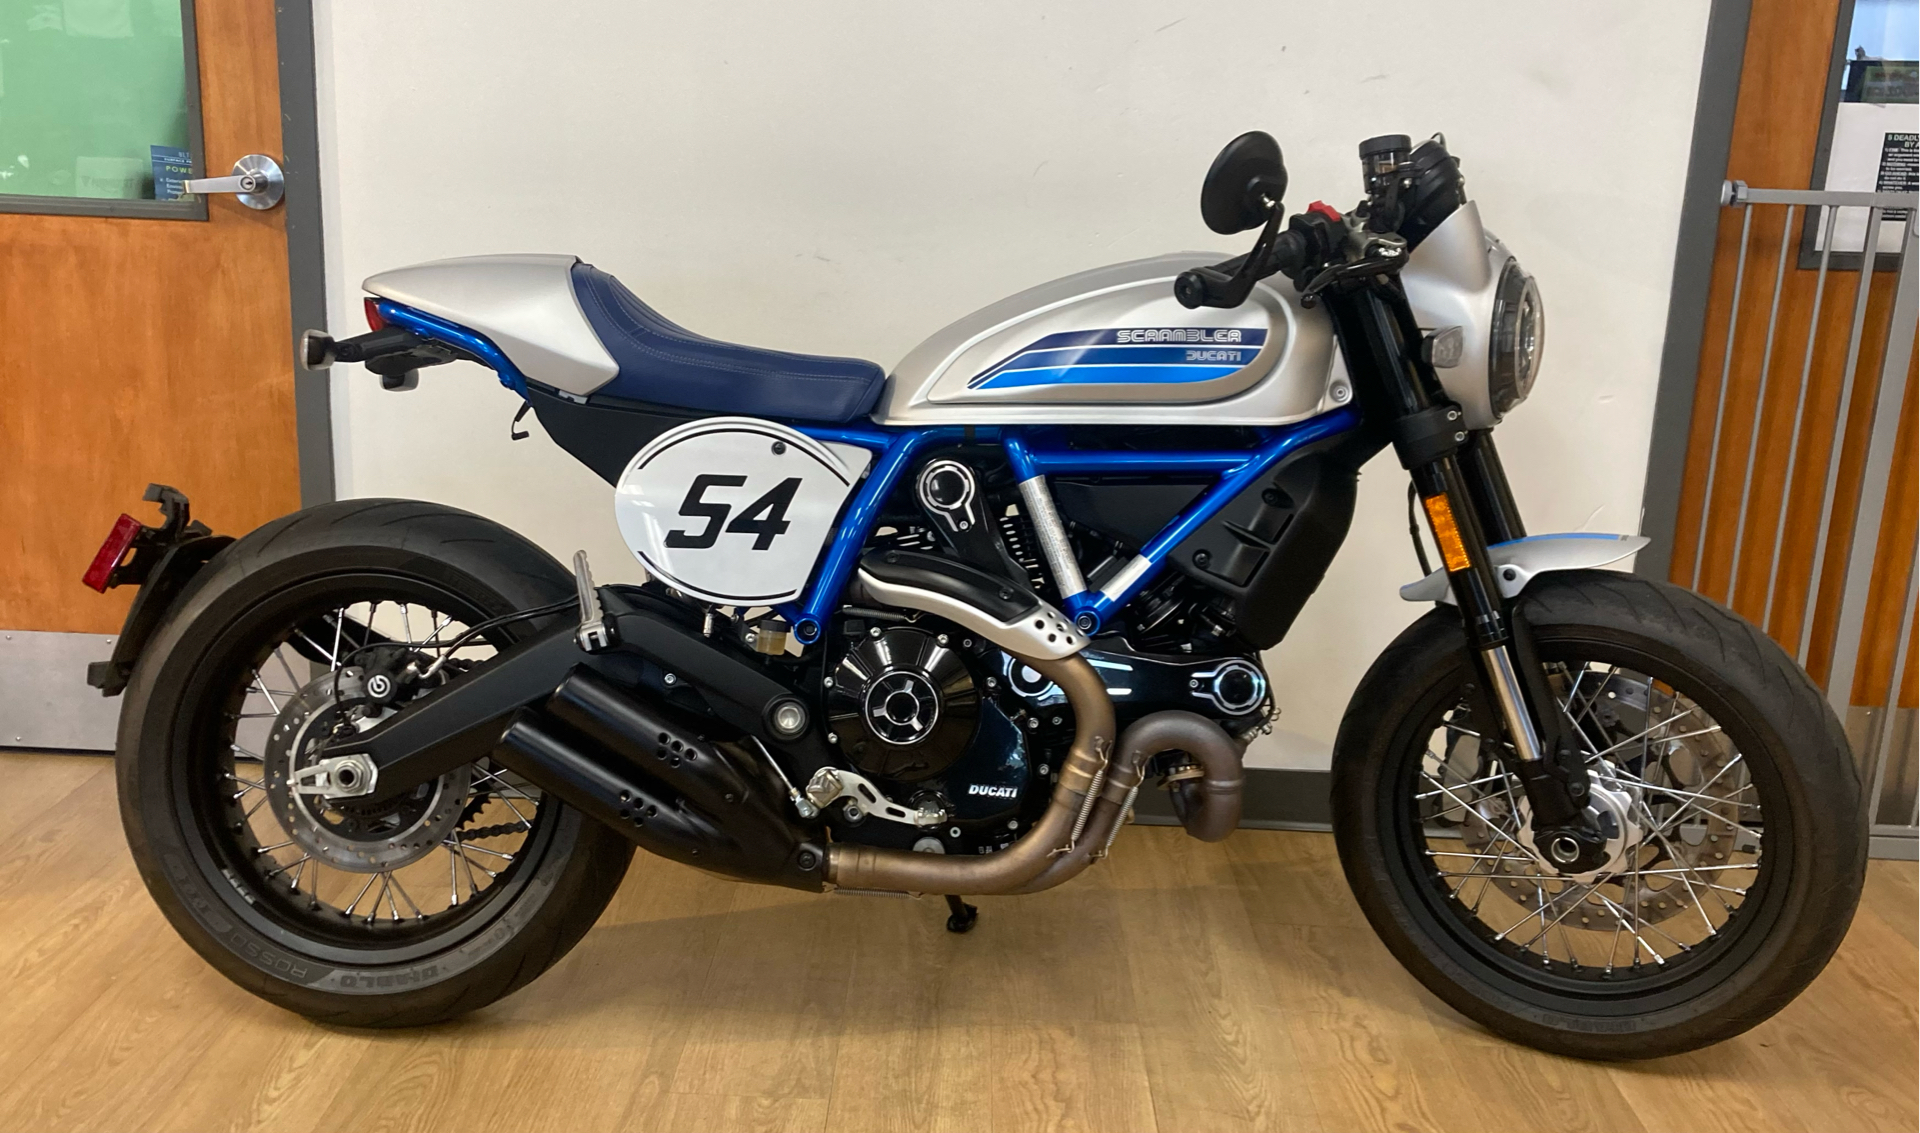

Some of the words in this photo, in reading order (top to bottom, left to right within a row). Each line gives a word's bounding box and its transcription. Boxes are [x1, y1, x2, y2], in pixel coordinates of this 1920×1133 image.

[1117, 329, 1242, 343] SCRAMBLER
[1186, 350, 1242, 362] DUCATI
[664, 474, 803, 551] 54
[968, 784, 1018, 798] DUCATI
[229, 931, 308, 979] ROSSO
